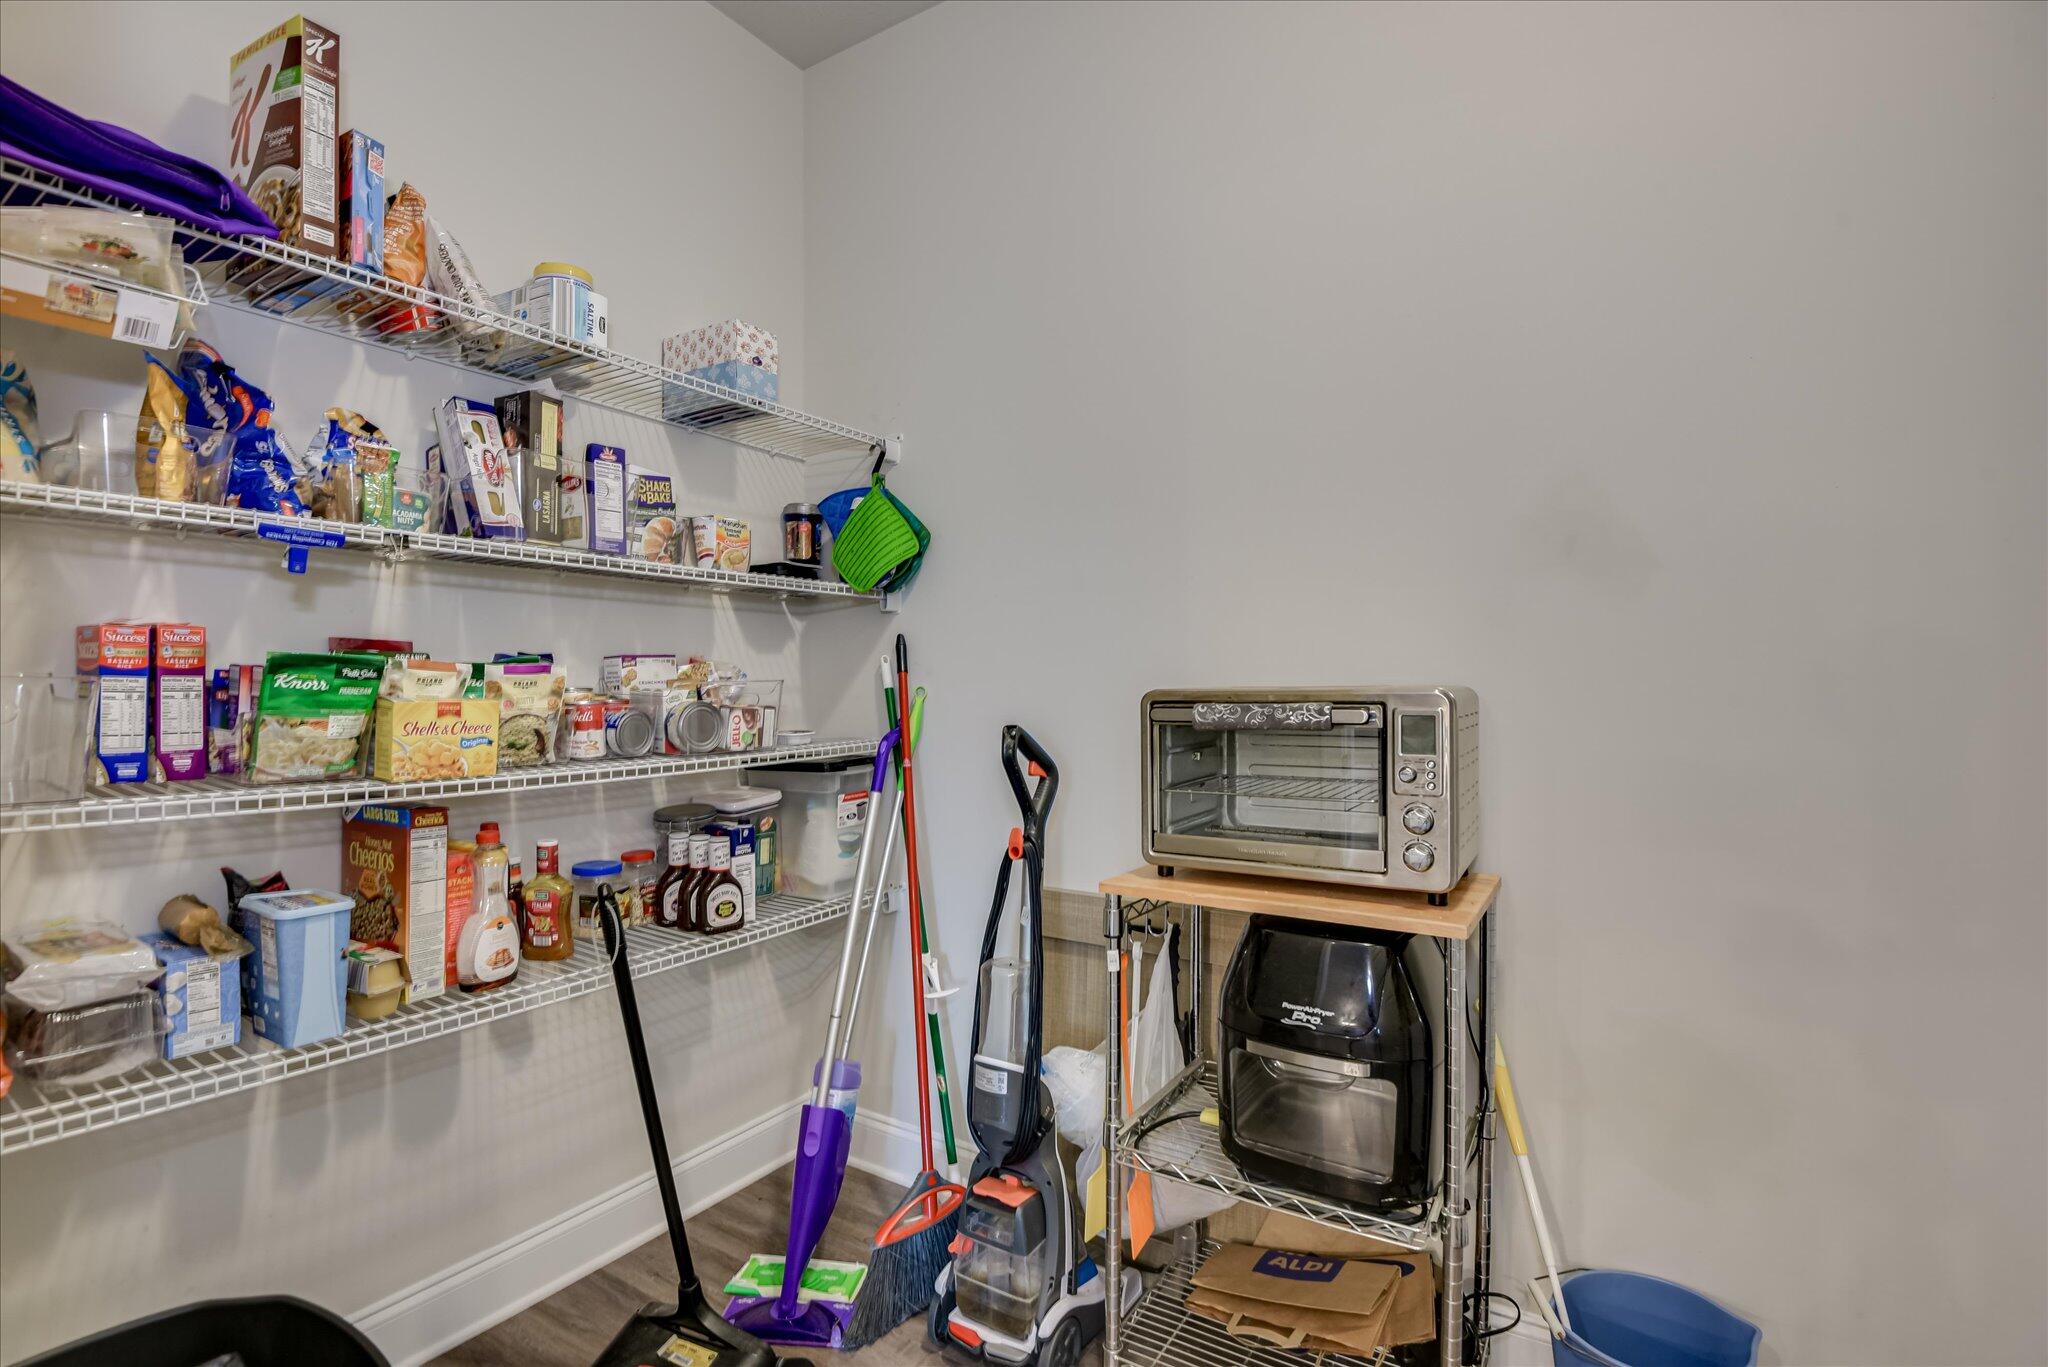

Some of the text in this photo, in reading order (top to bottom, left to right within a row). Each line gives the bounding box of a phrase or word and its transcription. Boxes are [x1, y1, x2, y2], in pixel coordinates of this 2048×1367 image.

[305, 26, 325, 40] SPECIAL
[236, 38, 263, 63] FAMILY
[437, 242, 457, 276] CRACKERS
[450, 272, 466, 294] SOUP
[586, 302, 595, 338] SALTINE
[639, 478, 671, 493] SHAKE
[646, 492, 672, 504] BAKE
[393, 509, 423, 521] ACADAMIA
[543, 491, 551, 524] LASAGNA
[397, 517, 415, 525] NUTS
[105, 630, 146, 643] Success
[162, 630, 201, 642] Success
[165, 657, 199, 665] JASMINE
[273, 673, 330, 692] Knorr
[338, 687, 373, 696] PARMESAN
[401, 720, 493, 737] Shells & Cheese
[461, 738, 489, 748] Original
[362, 806, 400, 824] LARGE SIZE
[414, 815, 445, 827] Cheerios
[365, 836, 393, 851] Honey Nut
[349, 841, 395, 872] Cheerios
[531, 901, 552, 909] ITALIAN
[1282, 1001, 1335, 1017] PowerAirFryer
[1292, 1011, 1321, 1025] Pro
[1268, 1256, 1333, 1273] ALDI
